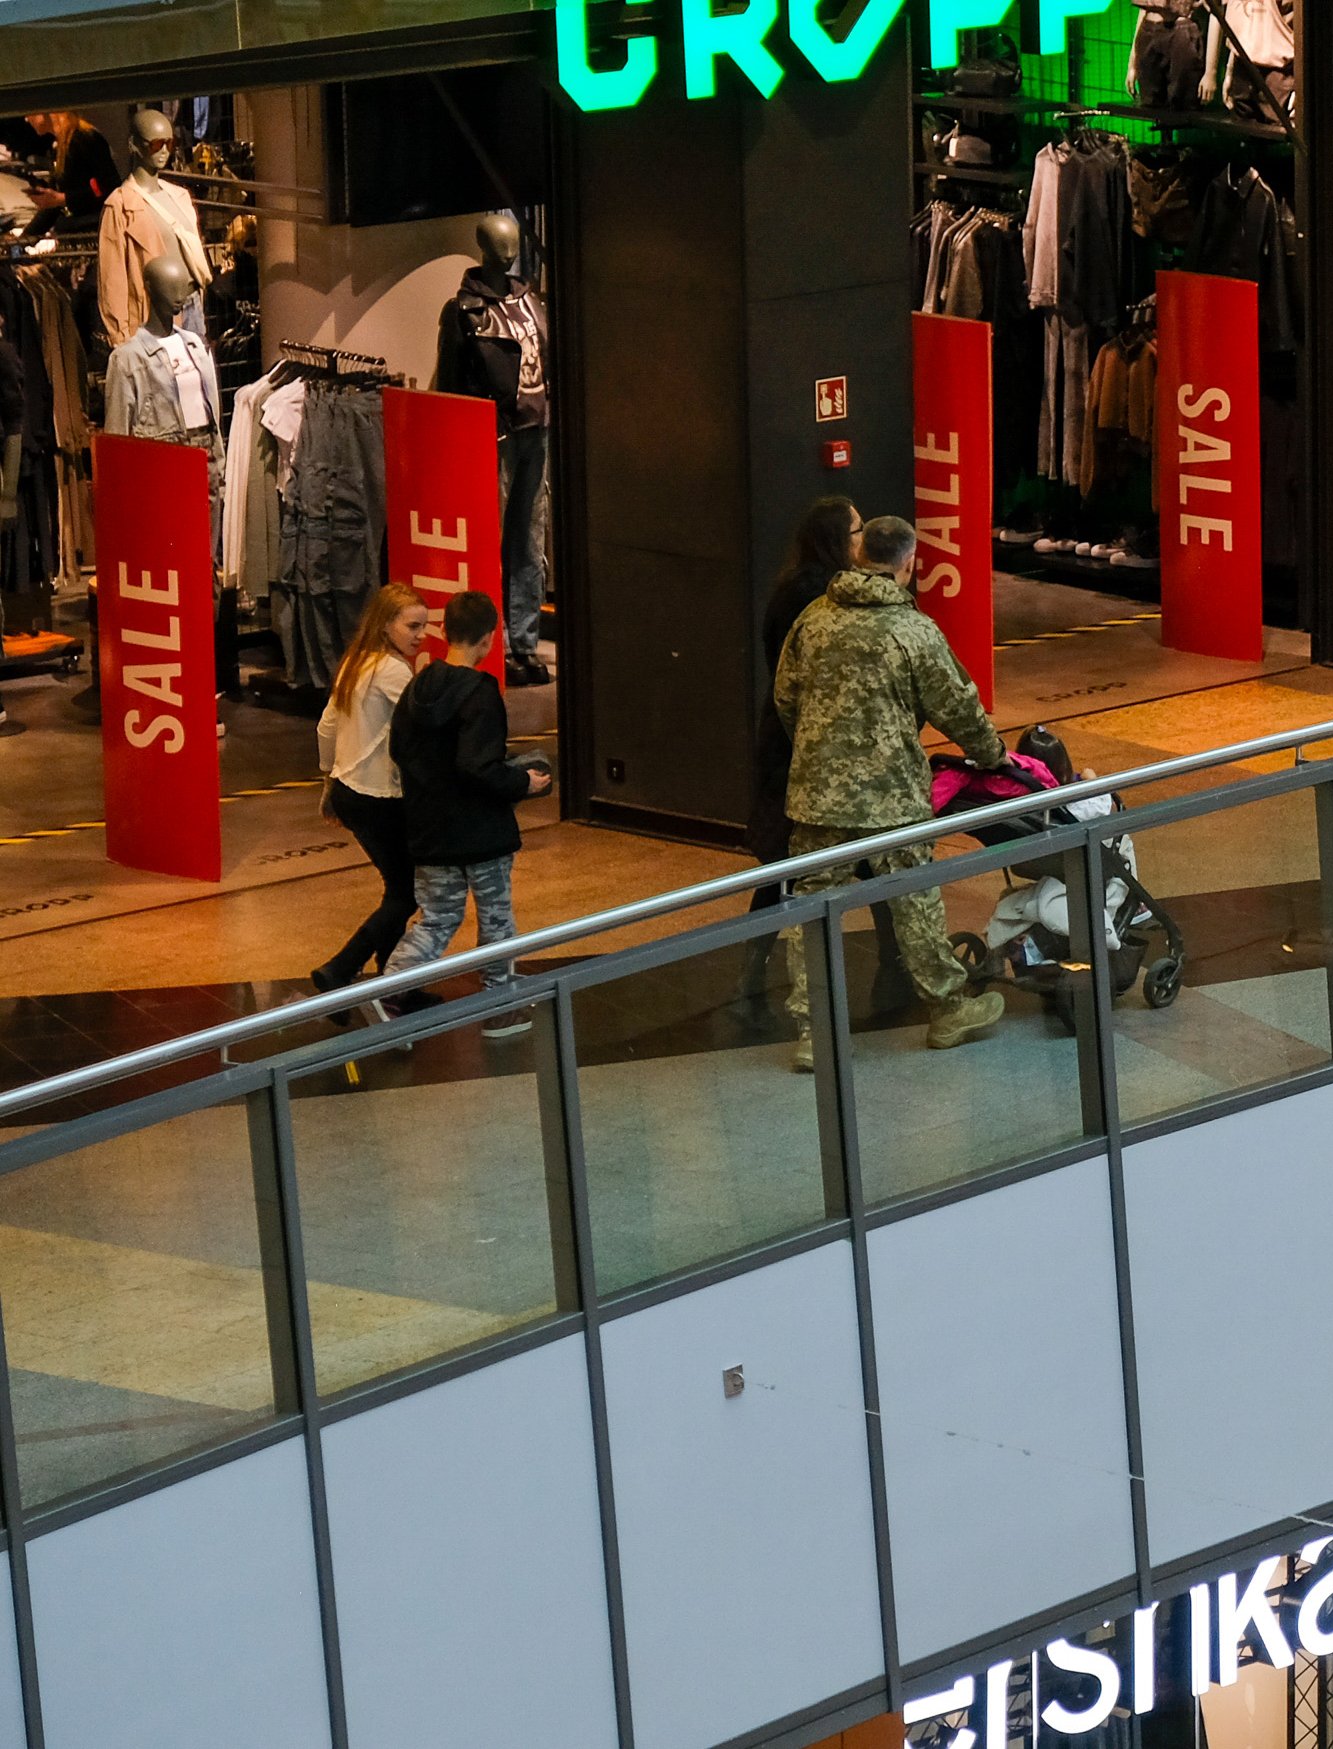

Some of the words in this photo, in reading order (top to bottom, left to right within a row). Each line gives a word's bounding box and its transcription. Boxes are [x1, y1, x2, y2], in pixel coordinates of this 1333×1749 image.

[914, 431, 961, 598] SALE
[1177, 383, 1233, 552] SALE
[118, 561, 185, 754] SALE
[409, 510, 468, 676] LE
